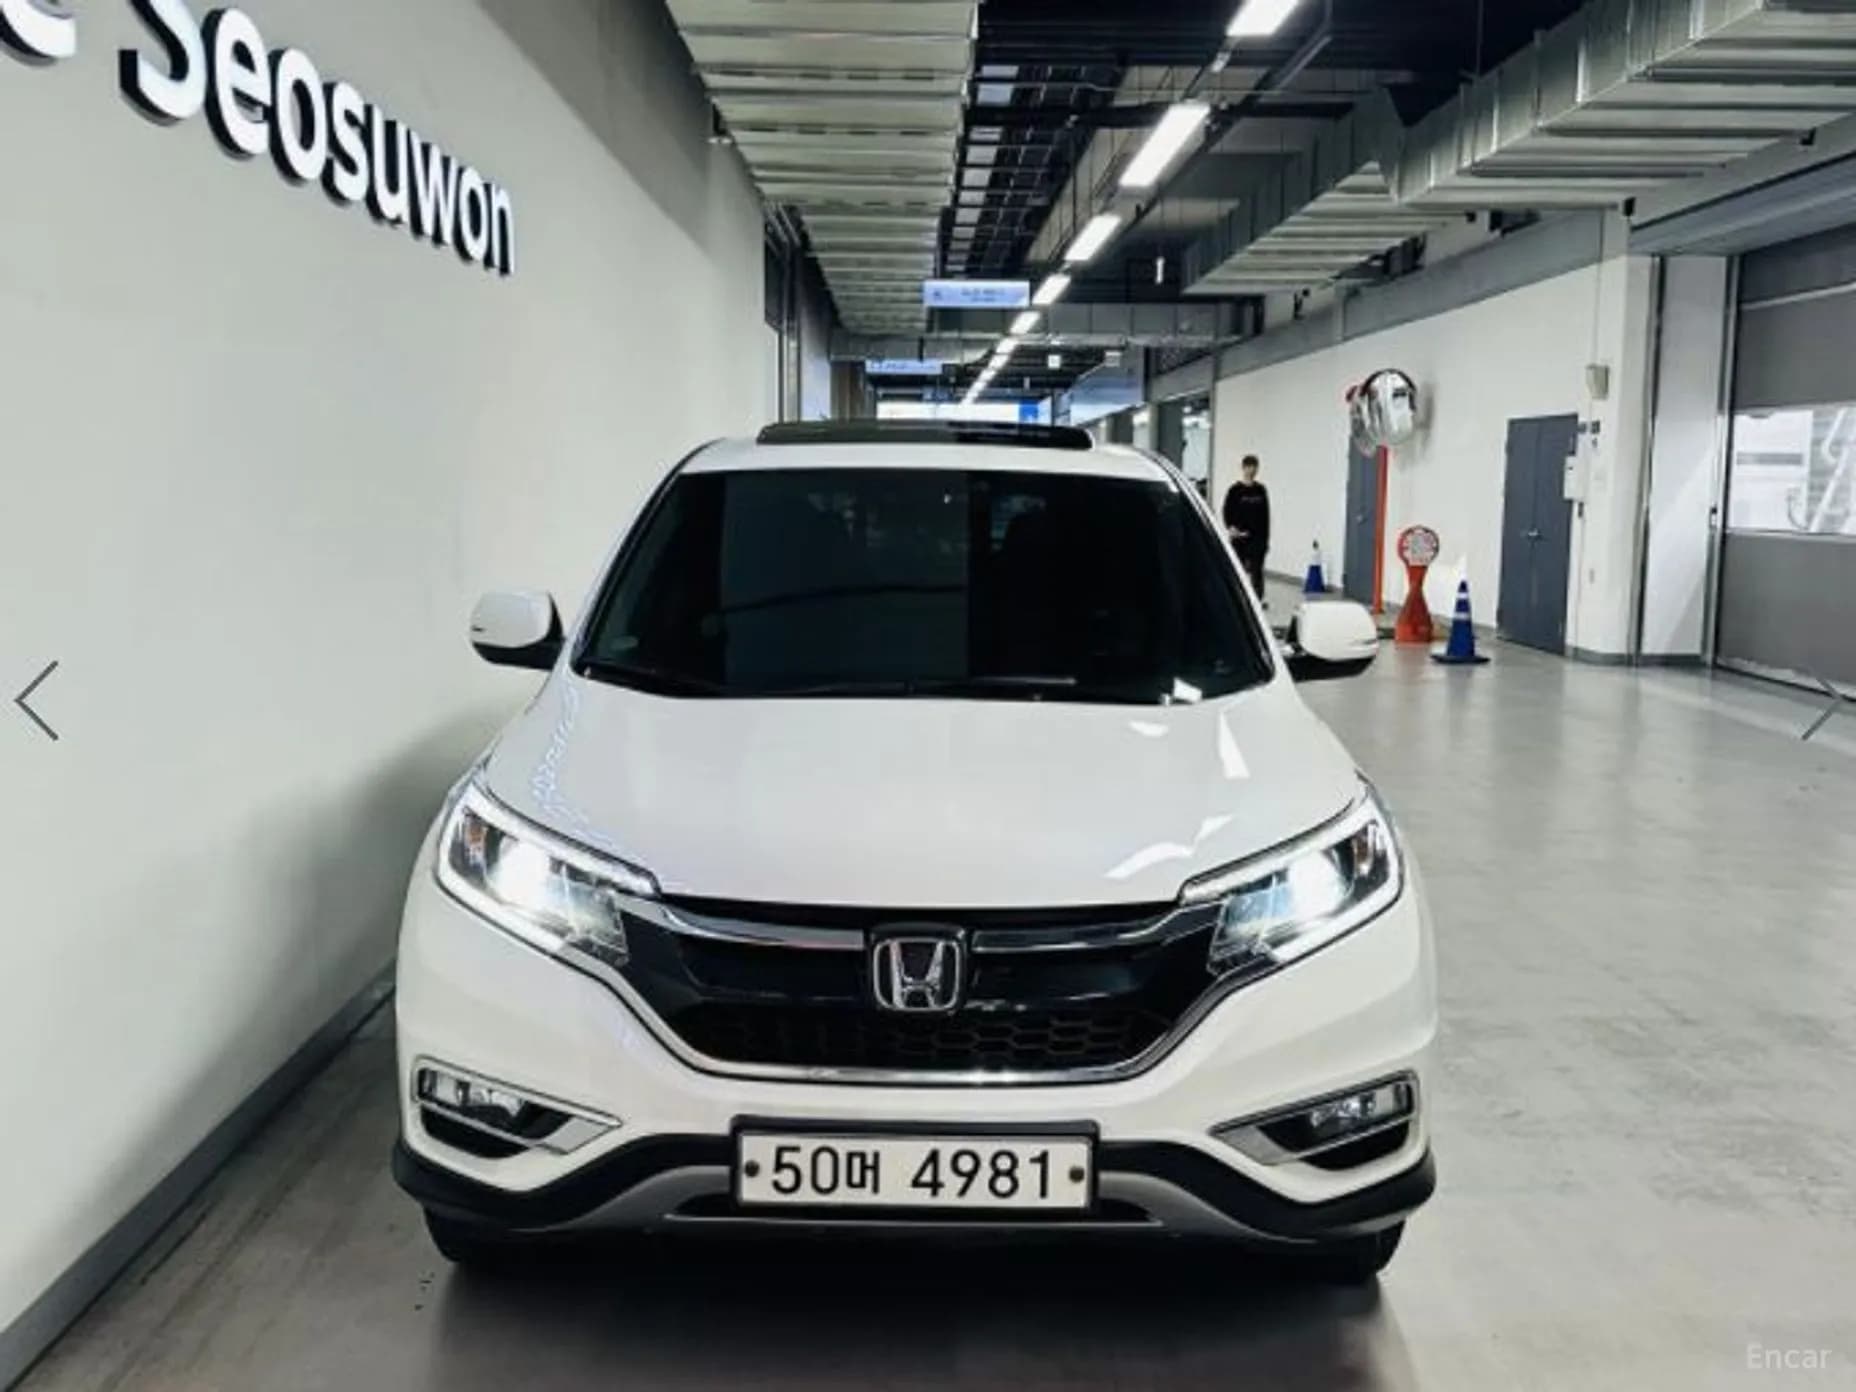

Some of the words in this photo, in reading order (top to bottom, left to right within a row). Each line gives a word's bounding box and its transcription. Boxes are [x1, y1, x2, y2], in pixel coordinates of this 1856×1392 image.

[118, 0, 515, 275] Seosuwon
[772, 1145, 881, 1195] 50머
[911, 1149, 1050, 1199] 4981
